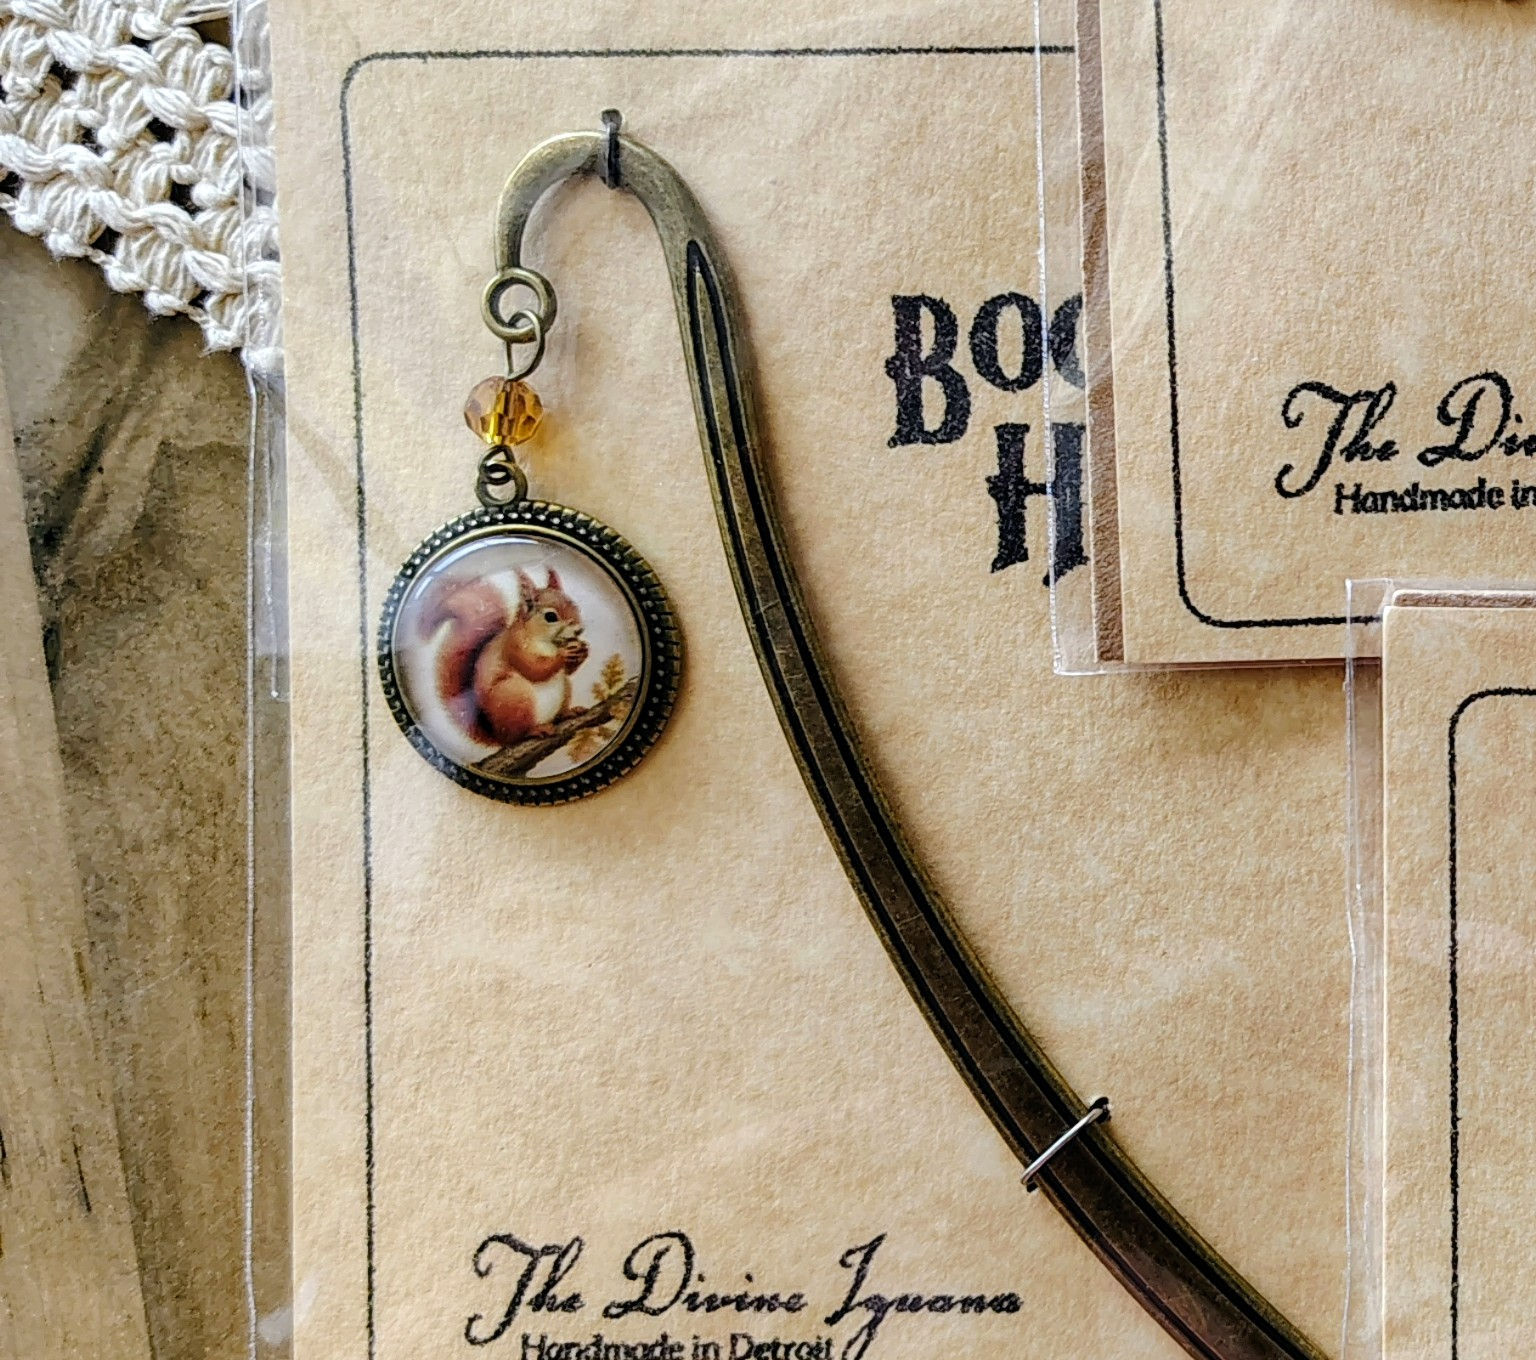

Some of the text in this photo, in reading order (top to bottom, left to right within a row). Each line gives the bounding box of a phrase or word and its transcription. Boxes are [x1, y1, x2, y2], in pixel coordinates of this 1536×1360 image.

[1275, 380, 1400, 498] The
[1334, 478, 1505, 515] Handmade
[464, 1232, 584, 1346] The
[602, 1229, 808, 1319] Divine
